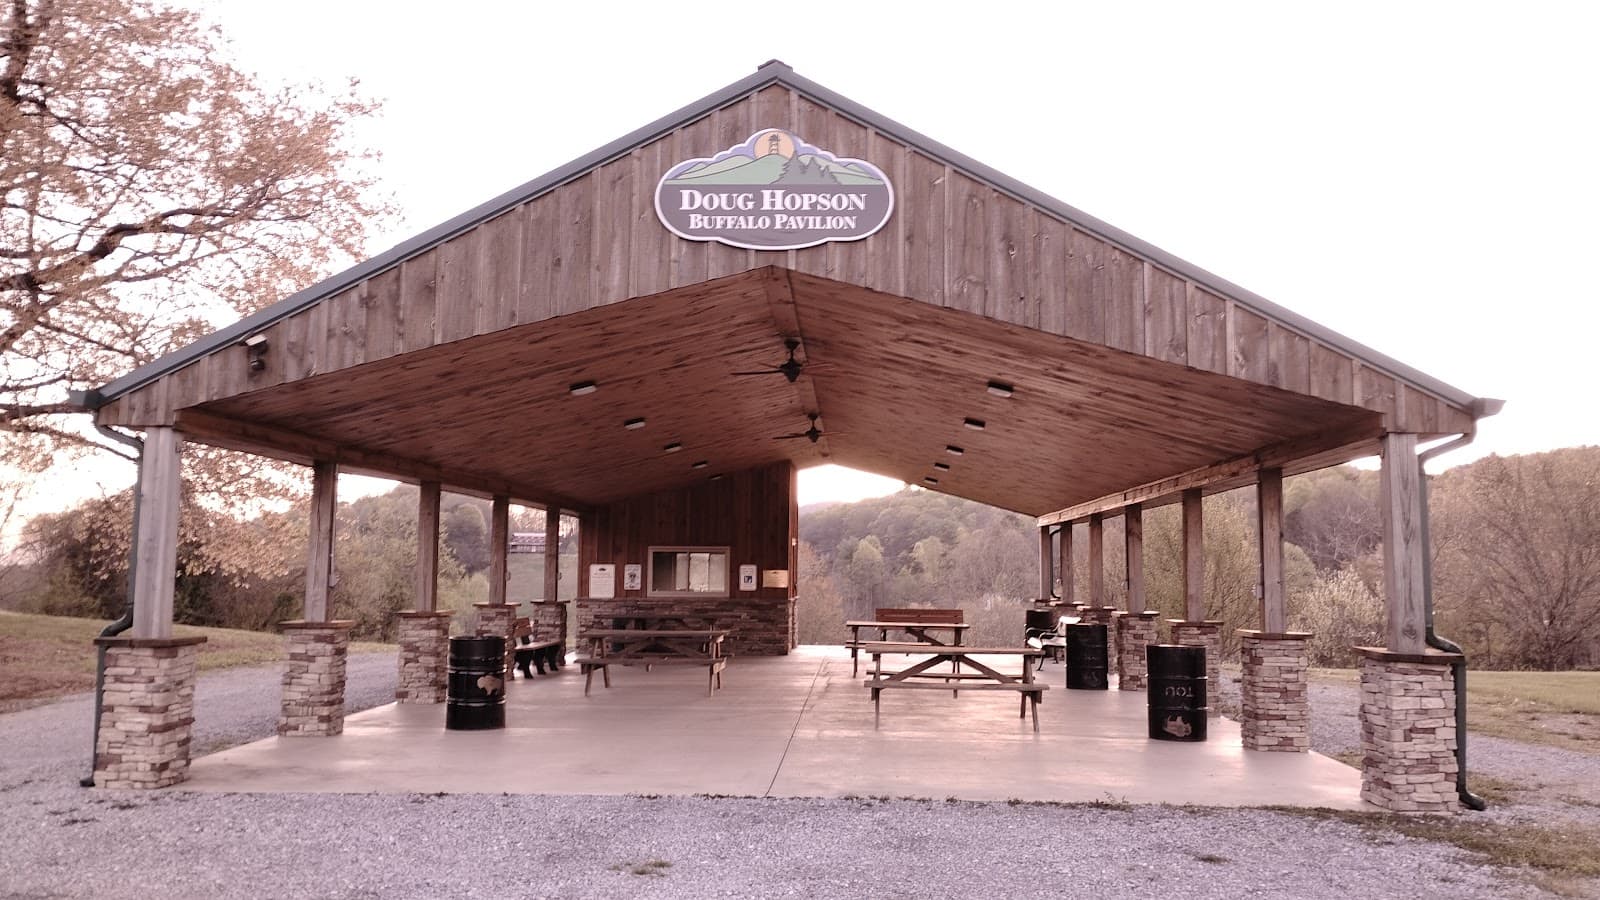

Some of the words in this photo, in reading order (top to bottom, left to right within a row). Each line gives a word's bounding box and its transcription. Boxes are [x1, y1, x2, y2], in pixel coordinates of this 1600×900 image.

[679, 189, 755, 210] DOUG
[760, 189, 867, 210] HOPSON
[689, 213, 770, 230] BUFFALO
[774, 213, 857, 230] PAVILION
